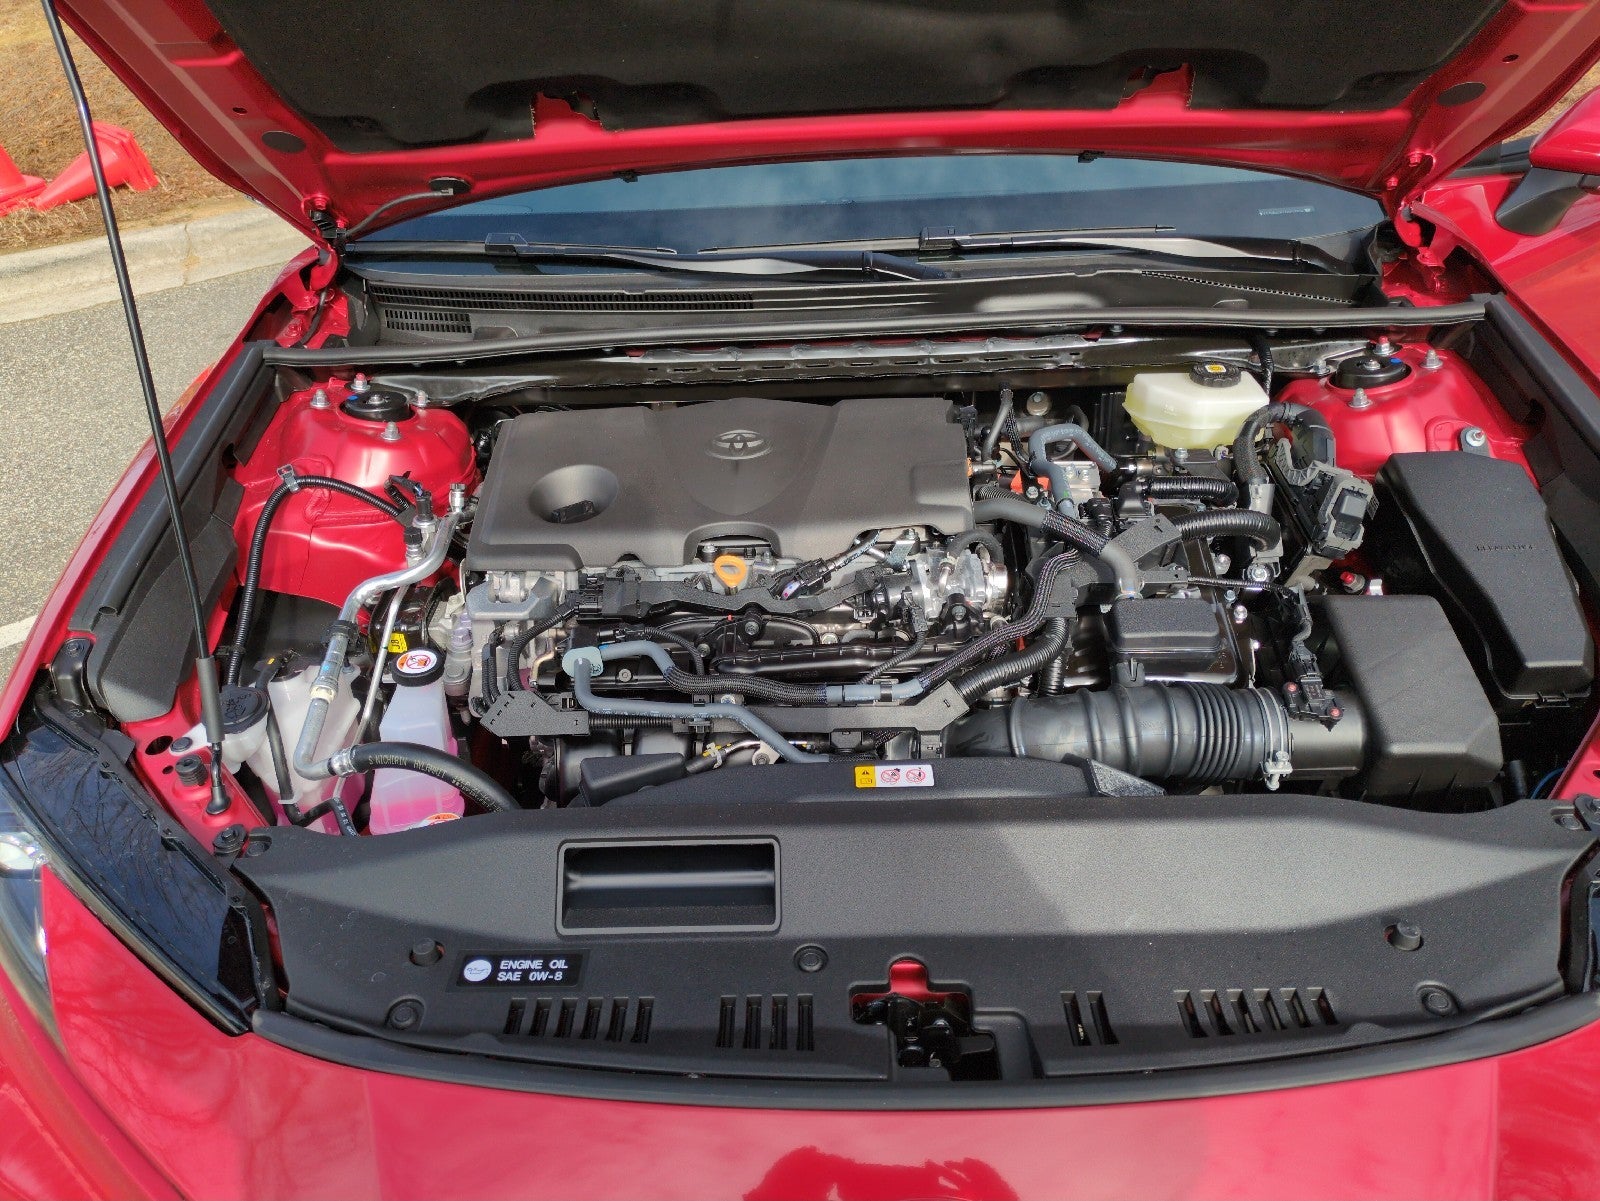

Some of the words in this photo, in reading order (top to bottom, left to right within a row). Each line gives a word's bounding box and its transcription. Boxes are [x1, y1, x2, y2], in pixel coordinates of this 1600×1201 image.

[499, 959, 544, 970] ENGINE
[548, 959, 569, 969] OIL
[496, 971, 522, 982] SAE
[528, 971, 563, 981] 0W-8
